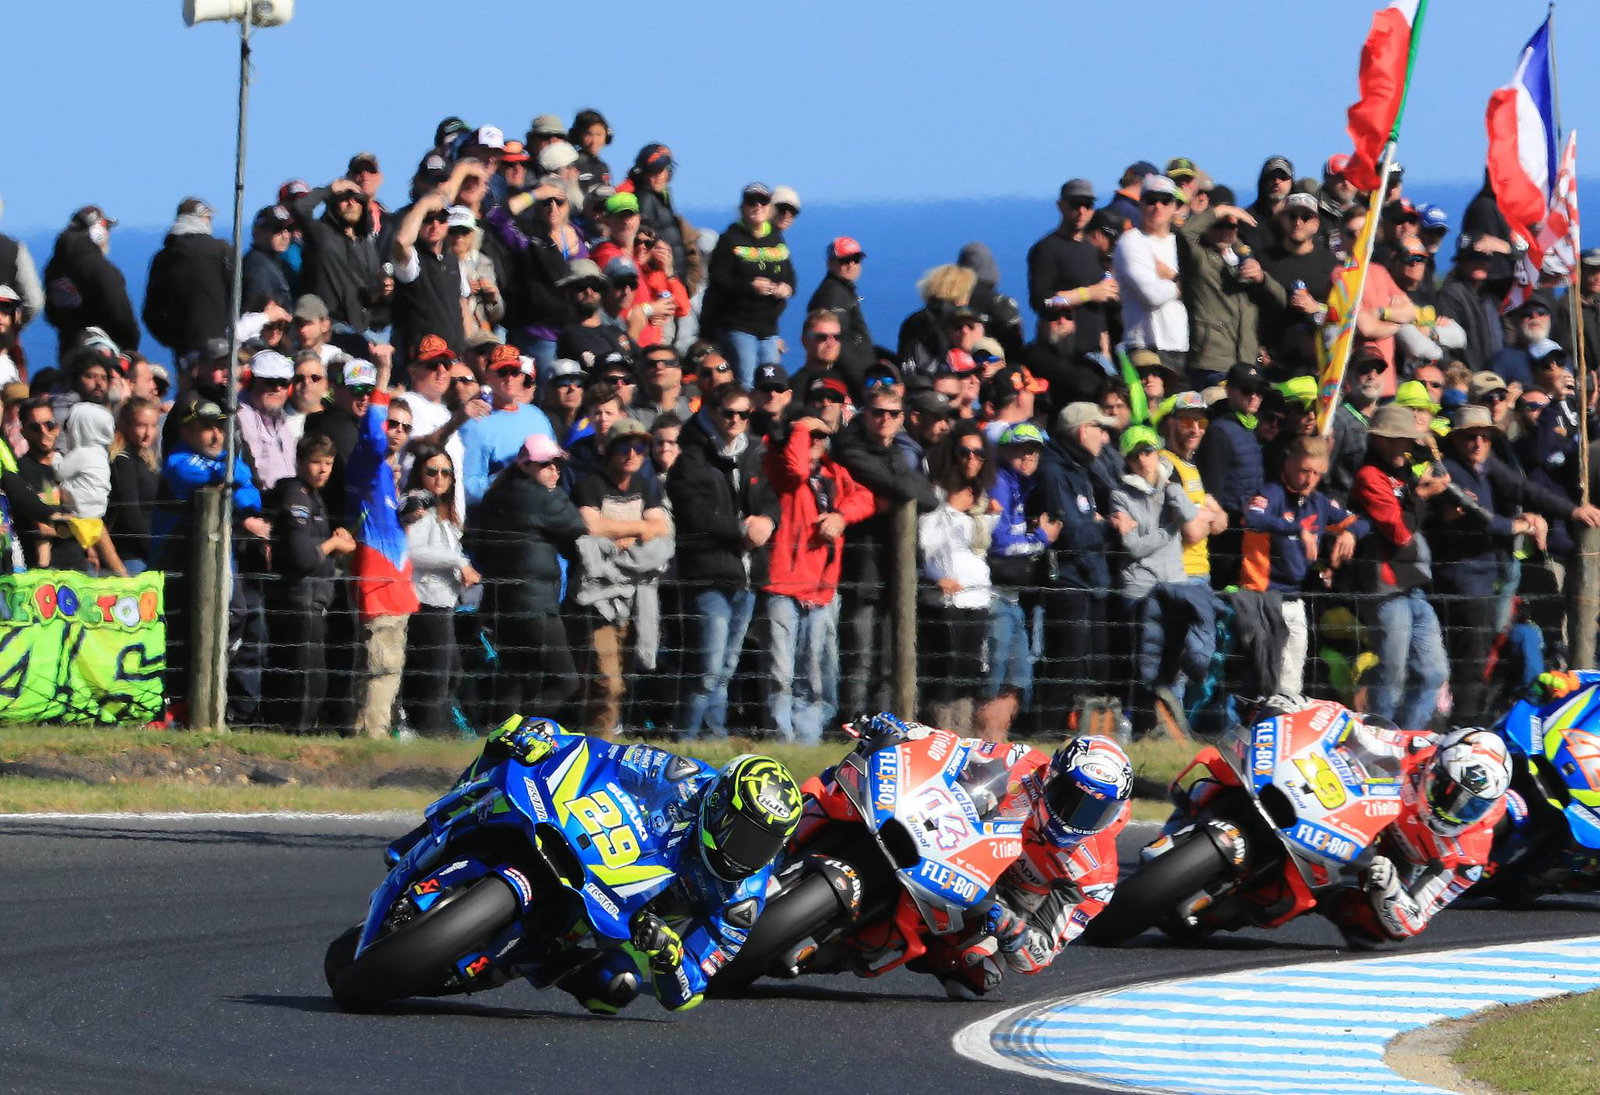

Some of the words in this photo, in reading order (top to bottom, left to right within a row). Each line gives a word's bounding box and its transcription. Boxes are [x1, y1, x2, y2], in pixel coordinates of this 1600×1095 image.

[1254, 722, 1275, 775] FLEX-BOX
[875, 752, 897, 811] FLEX-BOX
[562, 789, 641, 871] 29
[606, 782, 649, 842] SUZUKI
[760, 798, 788, 817] HJC
[1297, 824, 1357, 860] FLEX-BOX
[585, 882, 620, 921] ECSTAR
[920, 860, 980, 902] FLEX-BOX
